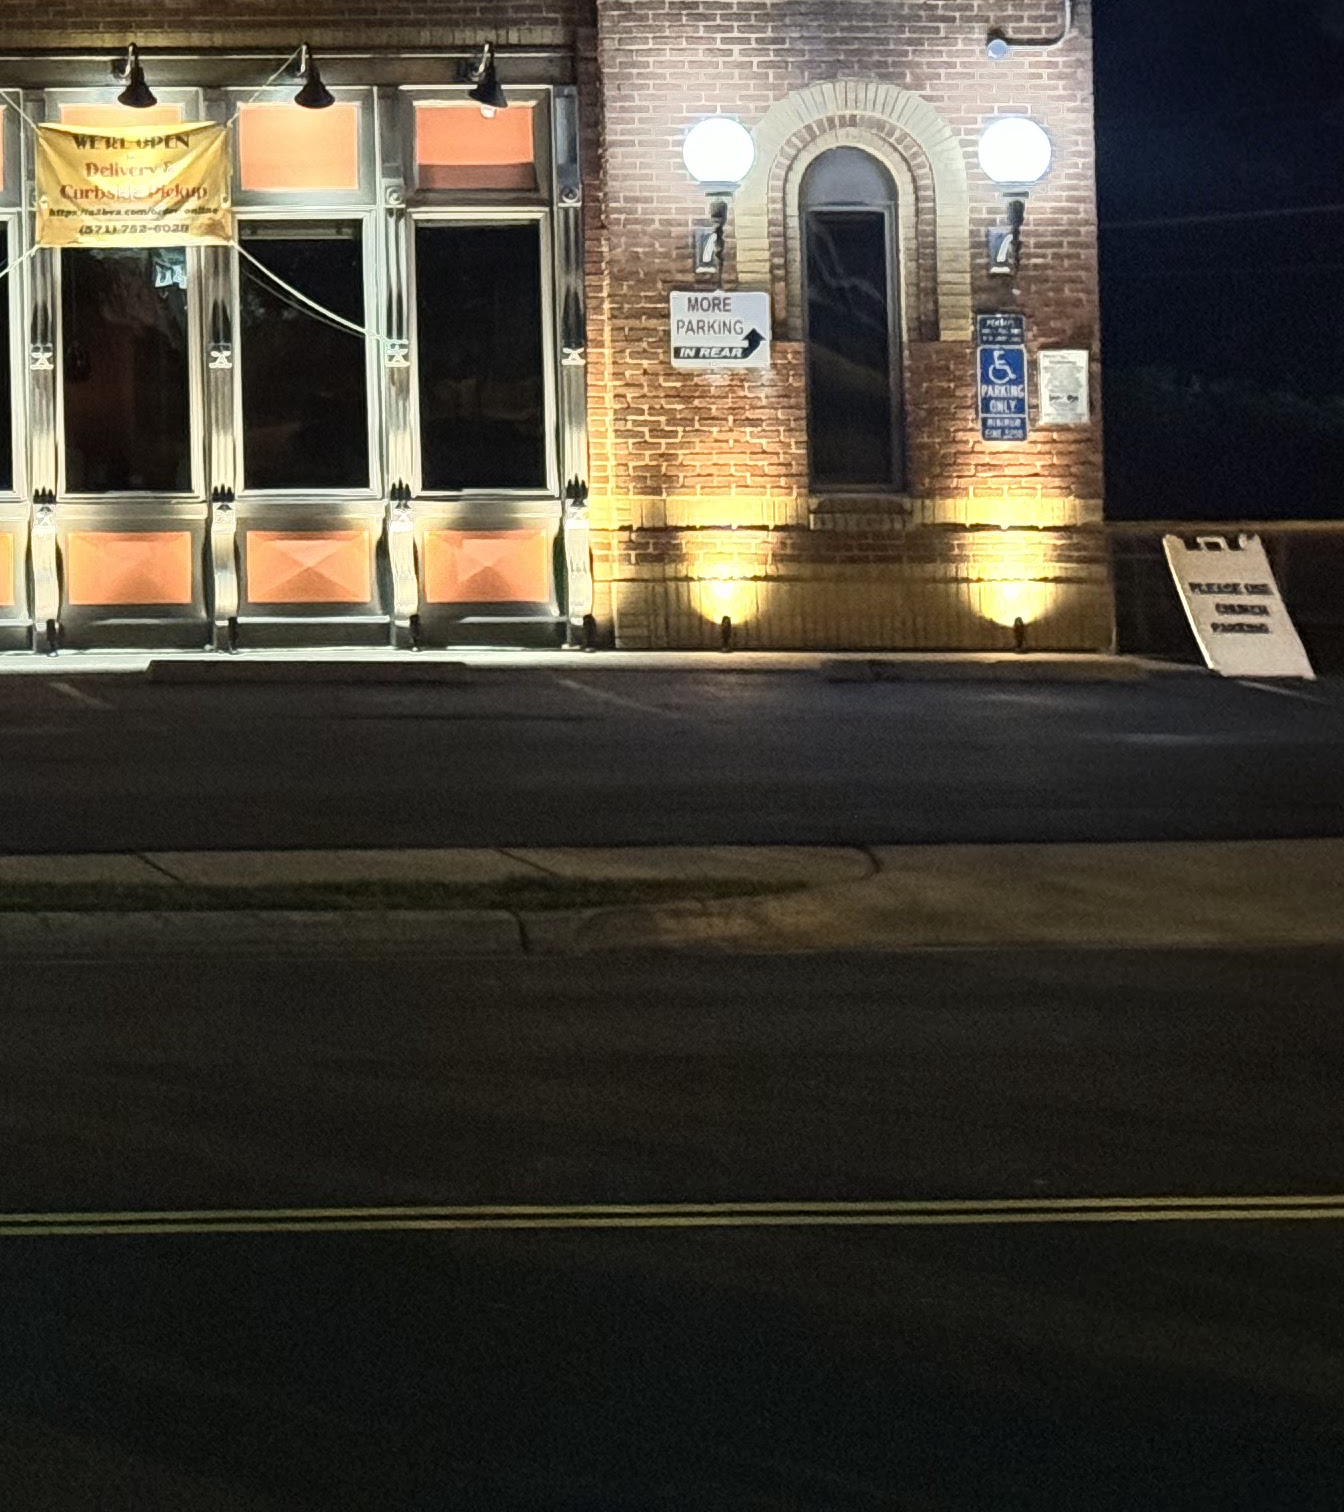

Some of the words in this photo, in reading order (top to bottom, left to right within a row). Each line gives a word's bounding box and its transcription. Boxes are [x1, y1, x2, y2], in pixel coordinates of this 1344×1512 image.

[137, 134, 190, 149] OPEN
[85, 162, 158, 178] Delivery
[687, 296, 732, 313] MORE
[676, 319, 744, 335] PARKING
[679, 347, 696, 358] IN
[699, 347, 744, 358] REAR
[981, 384, 1025, 398] PARKING
[989, 399, 1017, 413] ONLY
